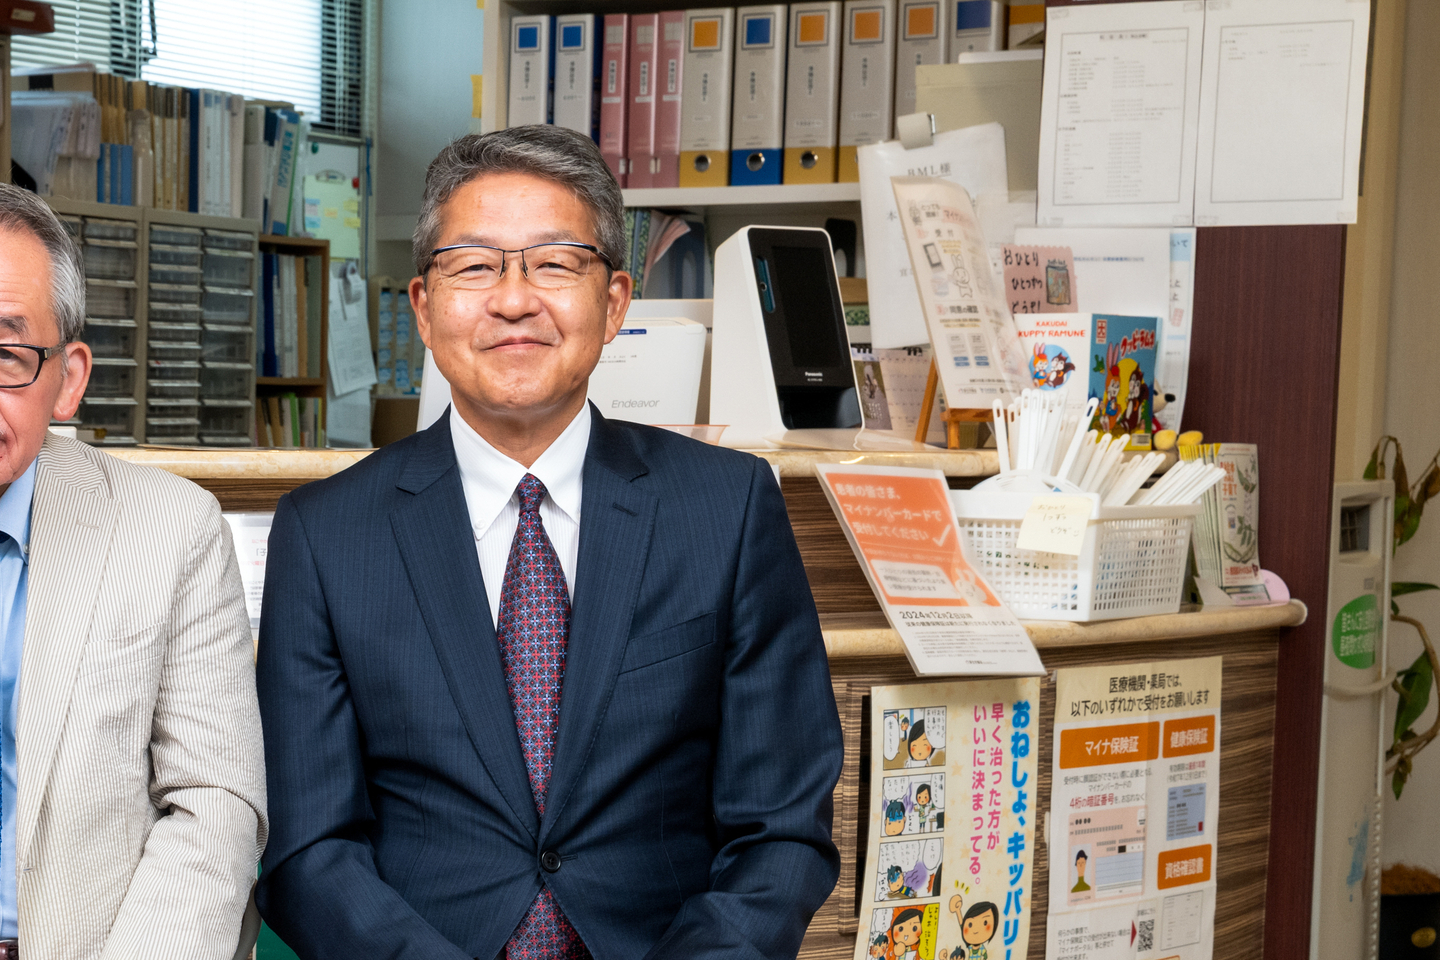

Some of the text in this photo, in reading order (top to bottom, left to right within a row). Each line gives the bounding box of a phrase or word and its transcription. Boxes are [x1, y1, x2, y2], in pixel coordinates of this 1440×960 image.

[1004, 247, 1040, 266] おひとり
[1018, 330, 1046, 338] KUPPY
[1121, 329, 1155, 357] クッピーラムネ
[611, 399, 660, 409] Endeavor
[835, 483, 901, 499] 患者の皆さま、
[843, 503, 943, 521] マイナンバーカードで
[852, 521, 929, 540] 受付してください
[899, 611, 973, 619] 2024年12月2日以降
[1109, 673, 1182, 694] 医療機関・薬局では、
[1071, 689, 1210, 717] 以下のいずれかで受付をお願いします
[1085, 736, 1139, 755] マイナ保険証
[1170, 728, 1208, 749] 健康保険証
[987, 703, 1004, 851] 早く治った方が
[969, 705, 987, 885] いいに決まってる。
[1165, 857, 1204, 880] 資格確認書
